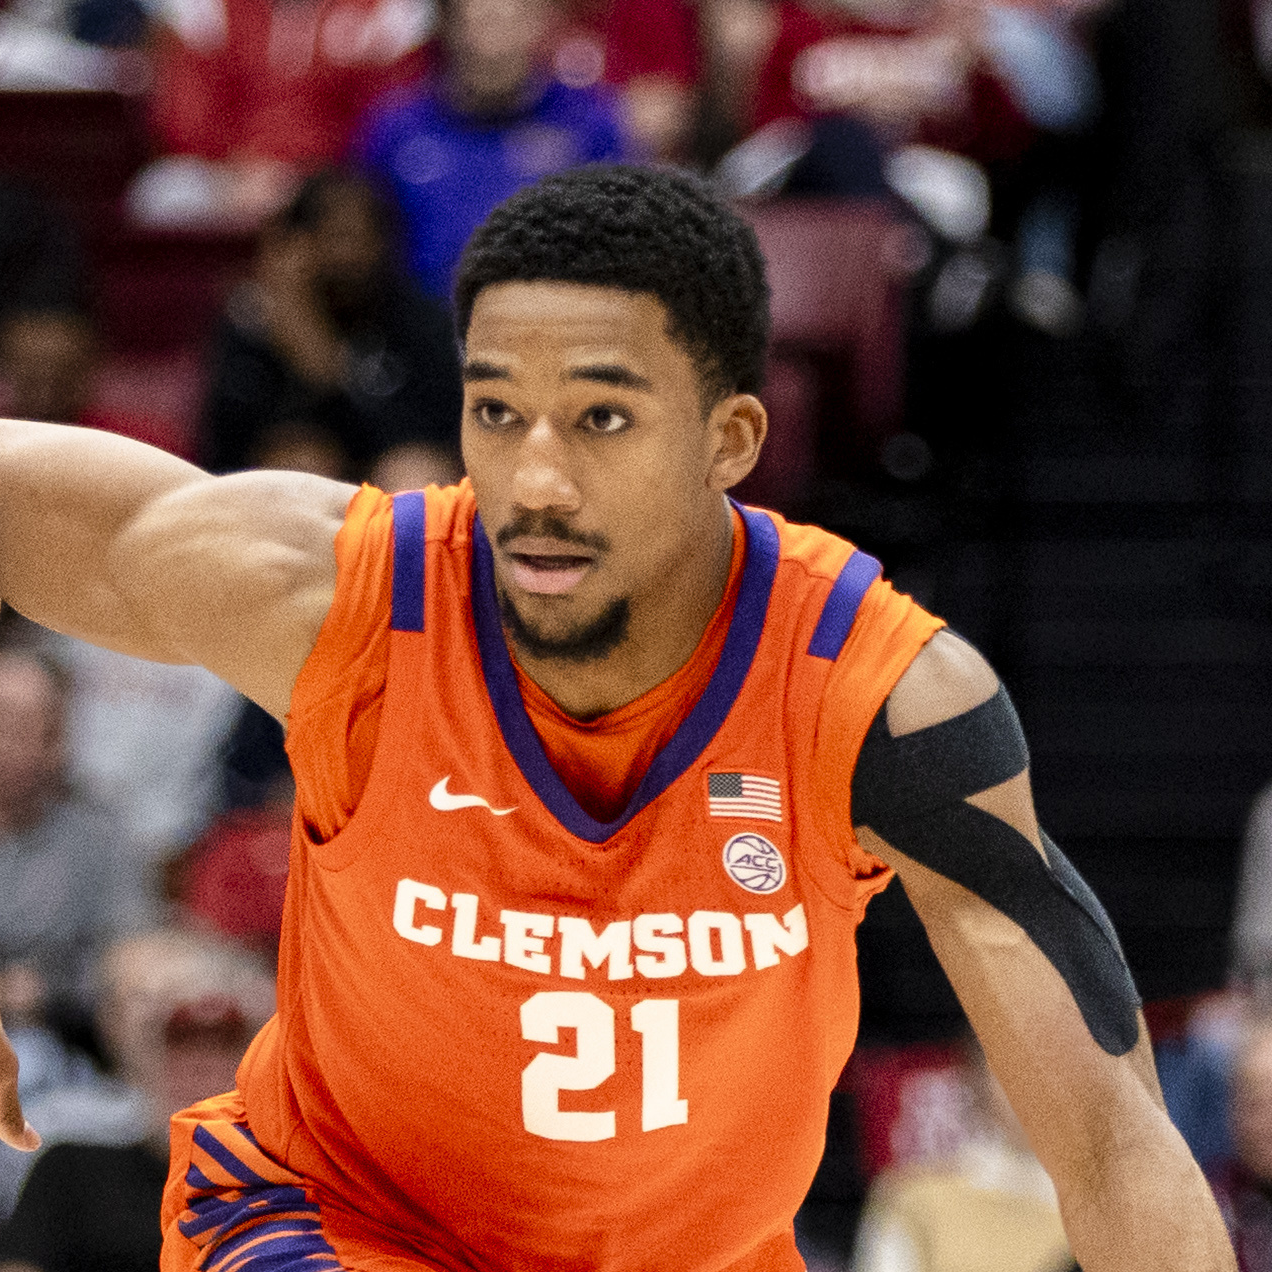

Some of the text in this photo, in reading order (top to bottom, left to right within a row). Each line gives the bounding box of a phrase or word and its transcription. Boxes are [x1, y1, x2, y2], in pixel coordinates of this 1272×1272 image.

[733, 852, 779, 870] ACC
[392, 877, 810, 981] CLEMSON
[519, 991, 689, 1143] 21
